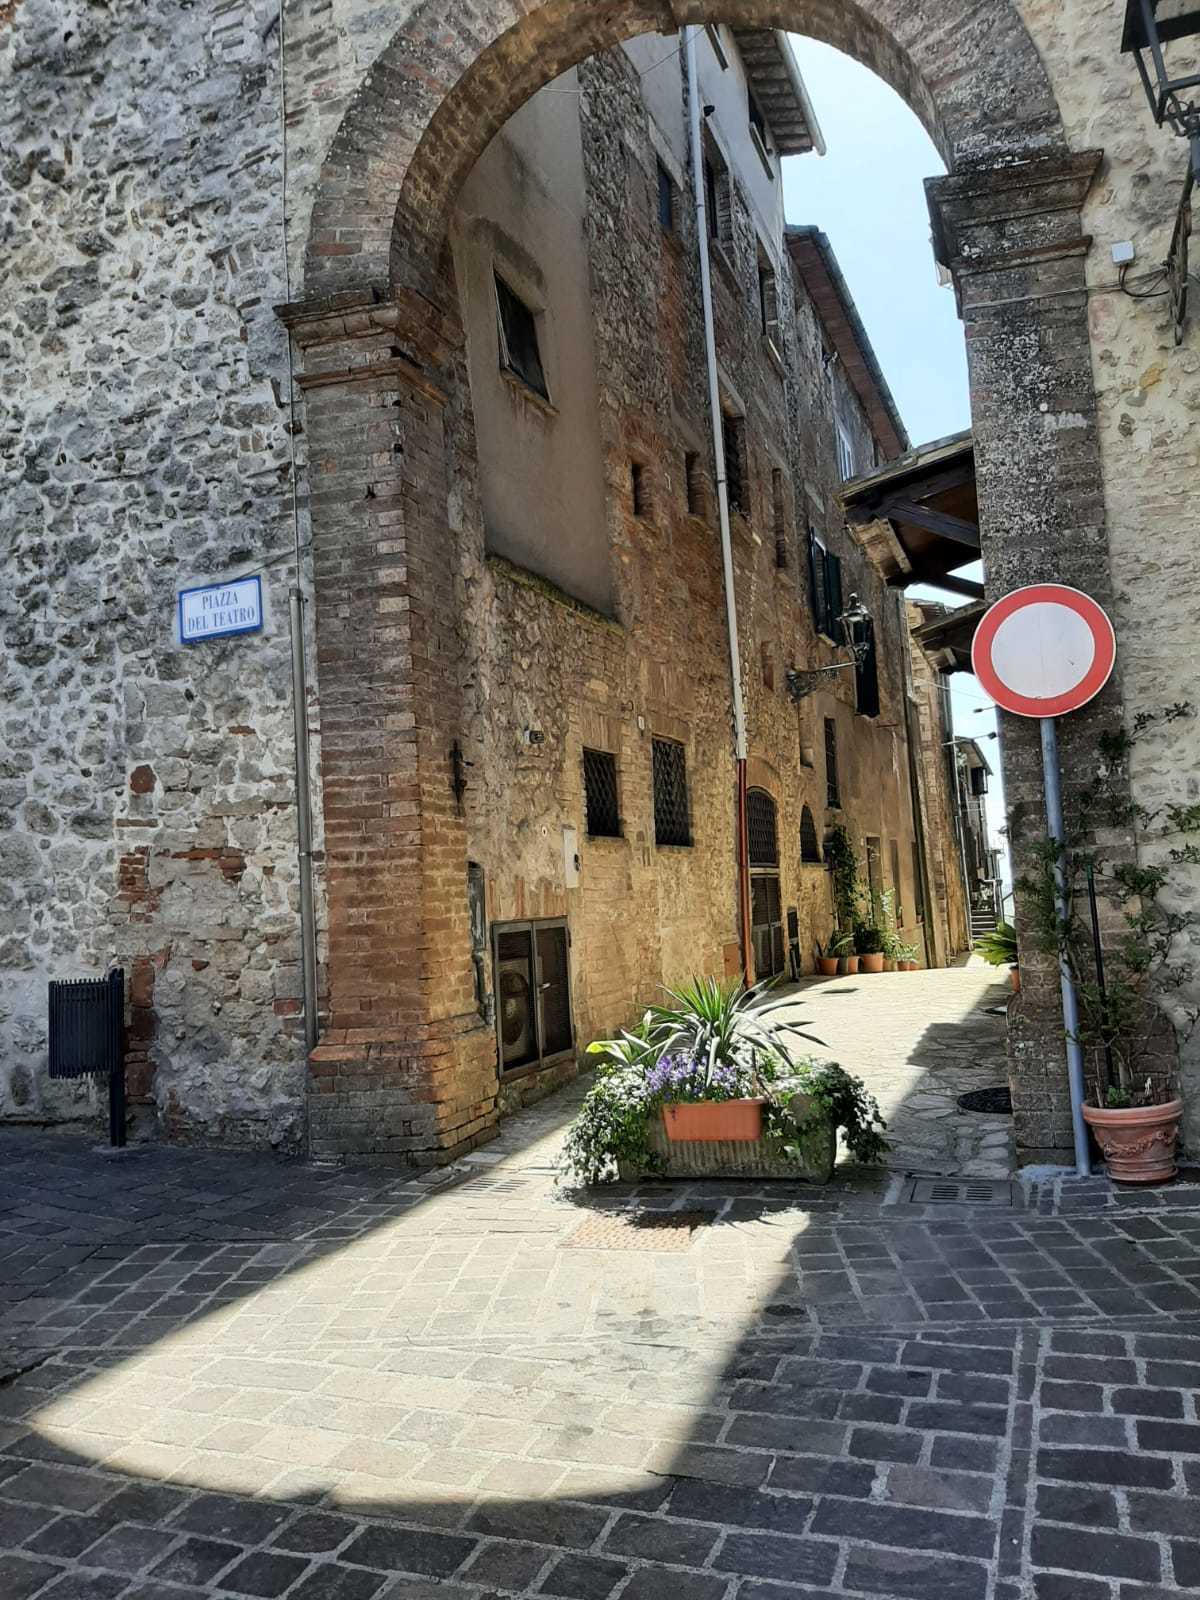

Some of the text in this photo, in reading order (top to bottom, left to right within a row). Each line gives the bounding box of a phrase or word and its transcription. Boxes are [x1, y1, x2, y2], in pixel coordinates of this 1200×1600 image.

[202, 591, 239, 610] PIAZZA
[188, 606, 255, 632] DEL TEATRO
